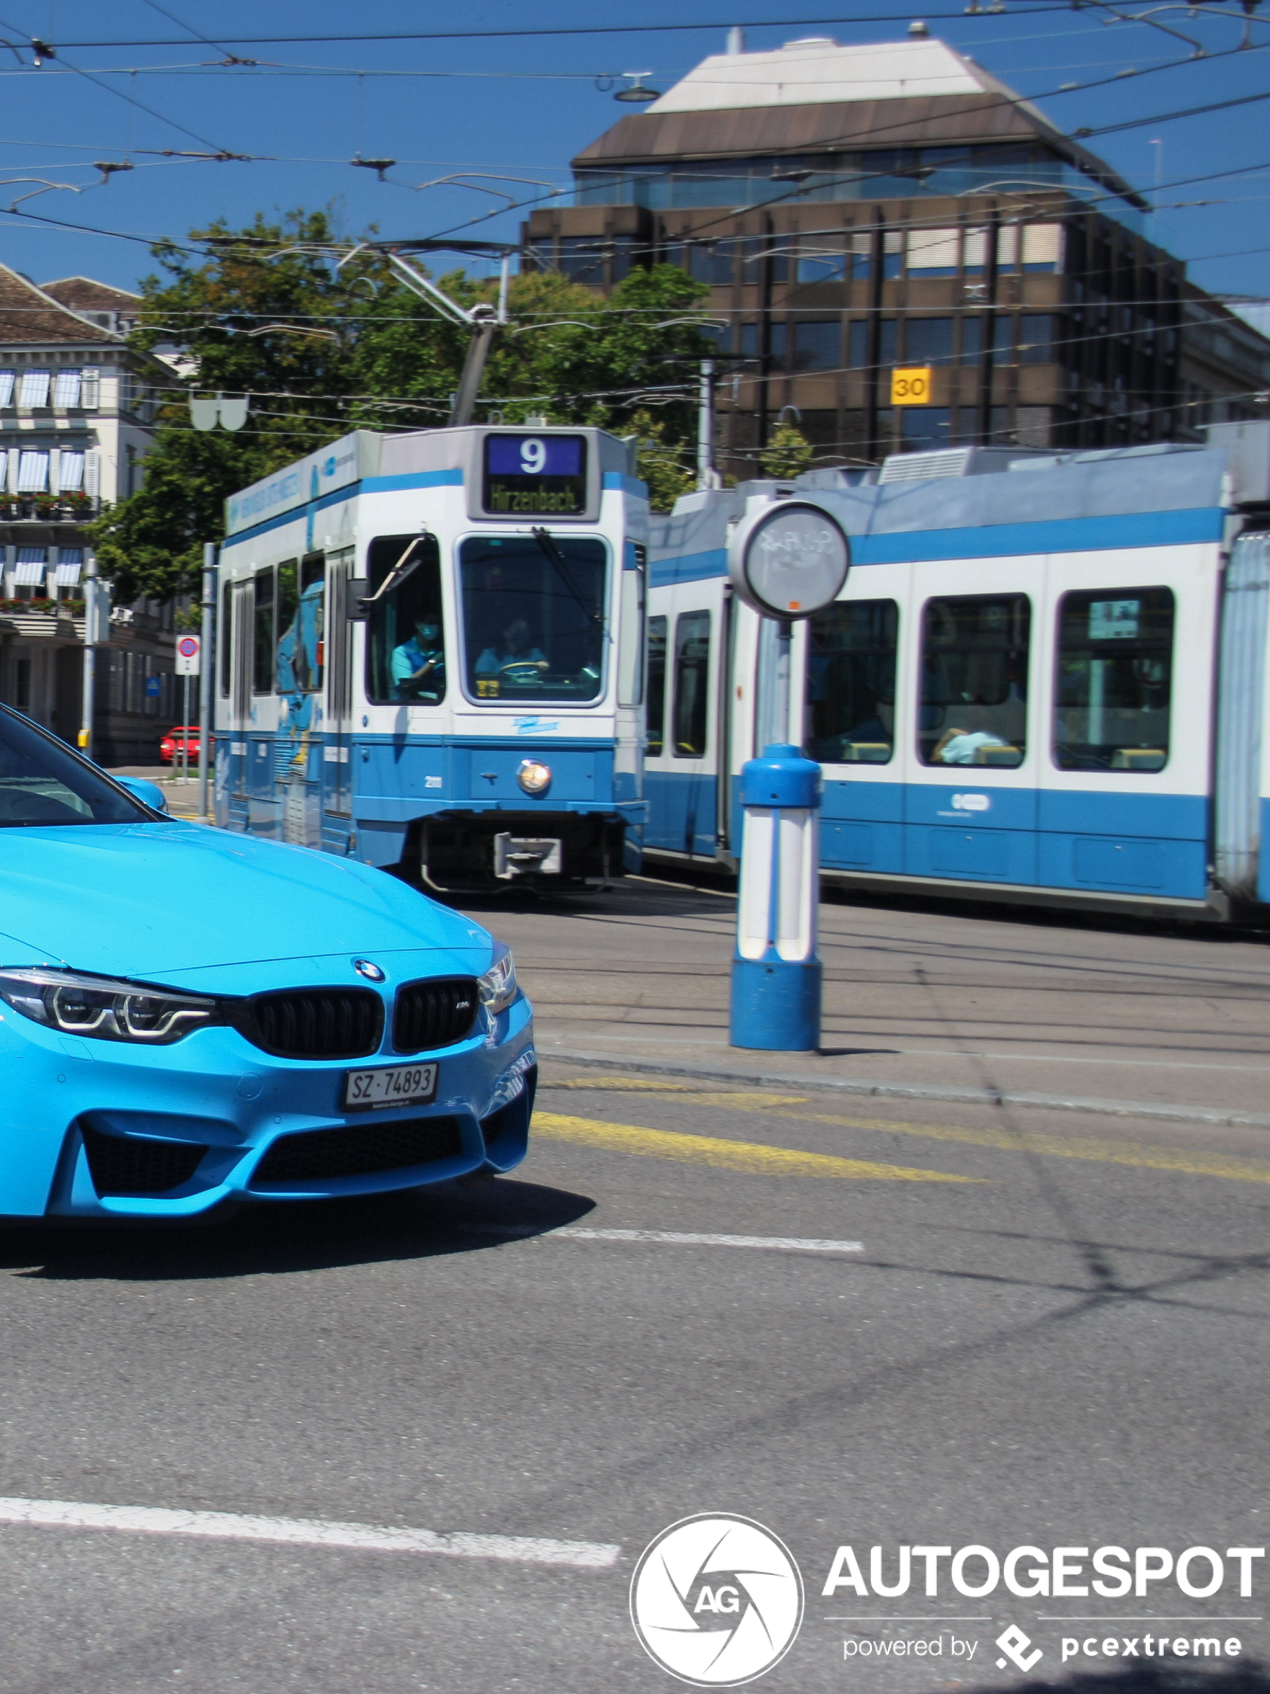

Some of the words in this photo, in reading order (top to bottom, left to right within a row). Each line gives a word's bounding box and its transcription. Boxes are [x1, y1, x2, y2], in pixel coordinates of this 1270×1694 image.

[894, 378, 926, 397] 30
[519, 438, 546, 474] 9
[352, 1075, 374, 1098] SZ
[384, 1068, 431, 1096] 74893
